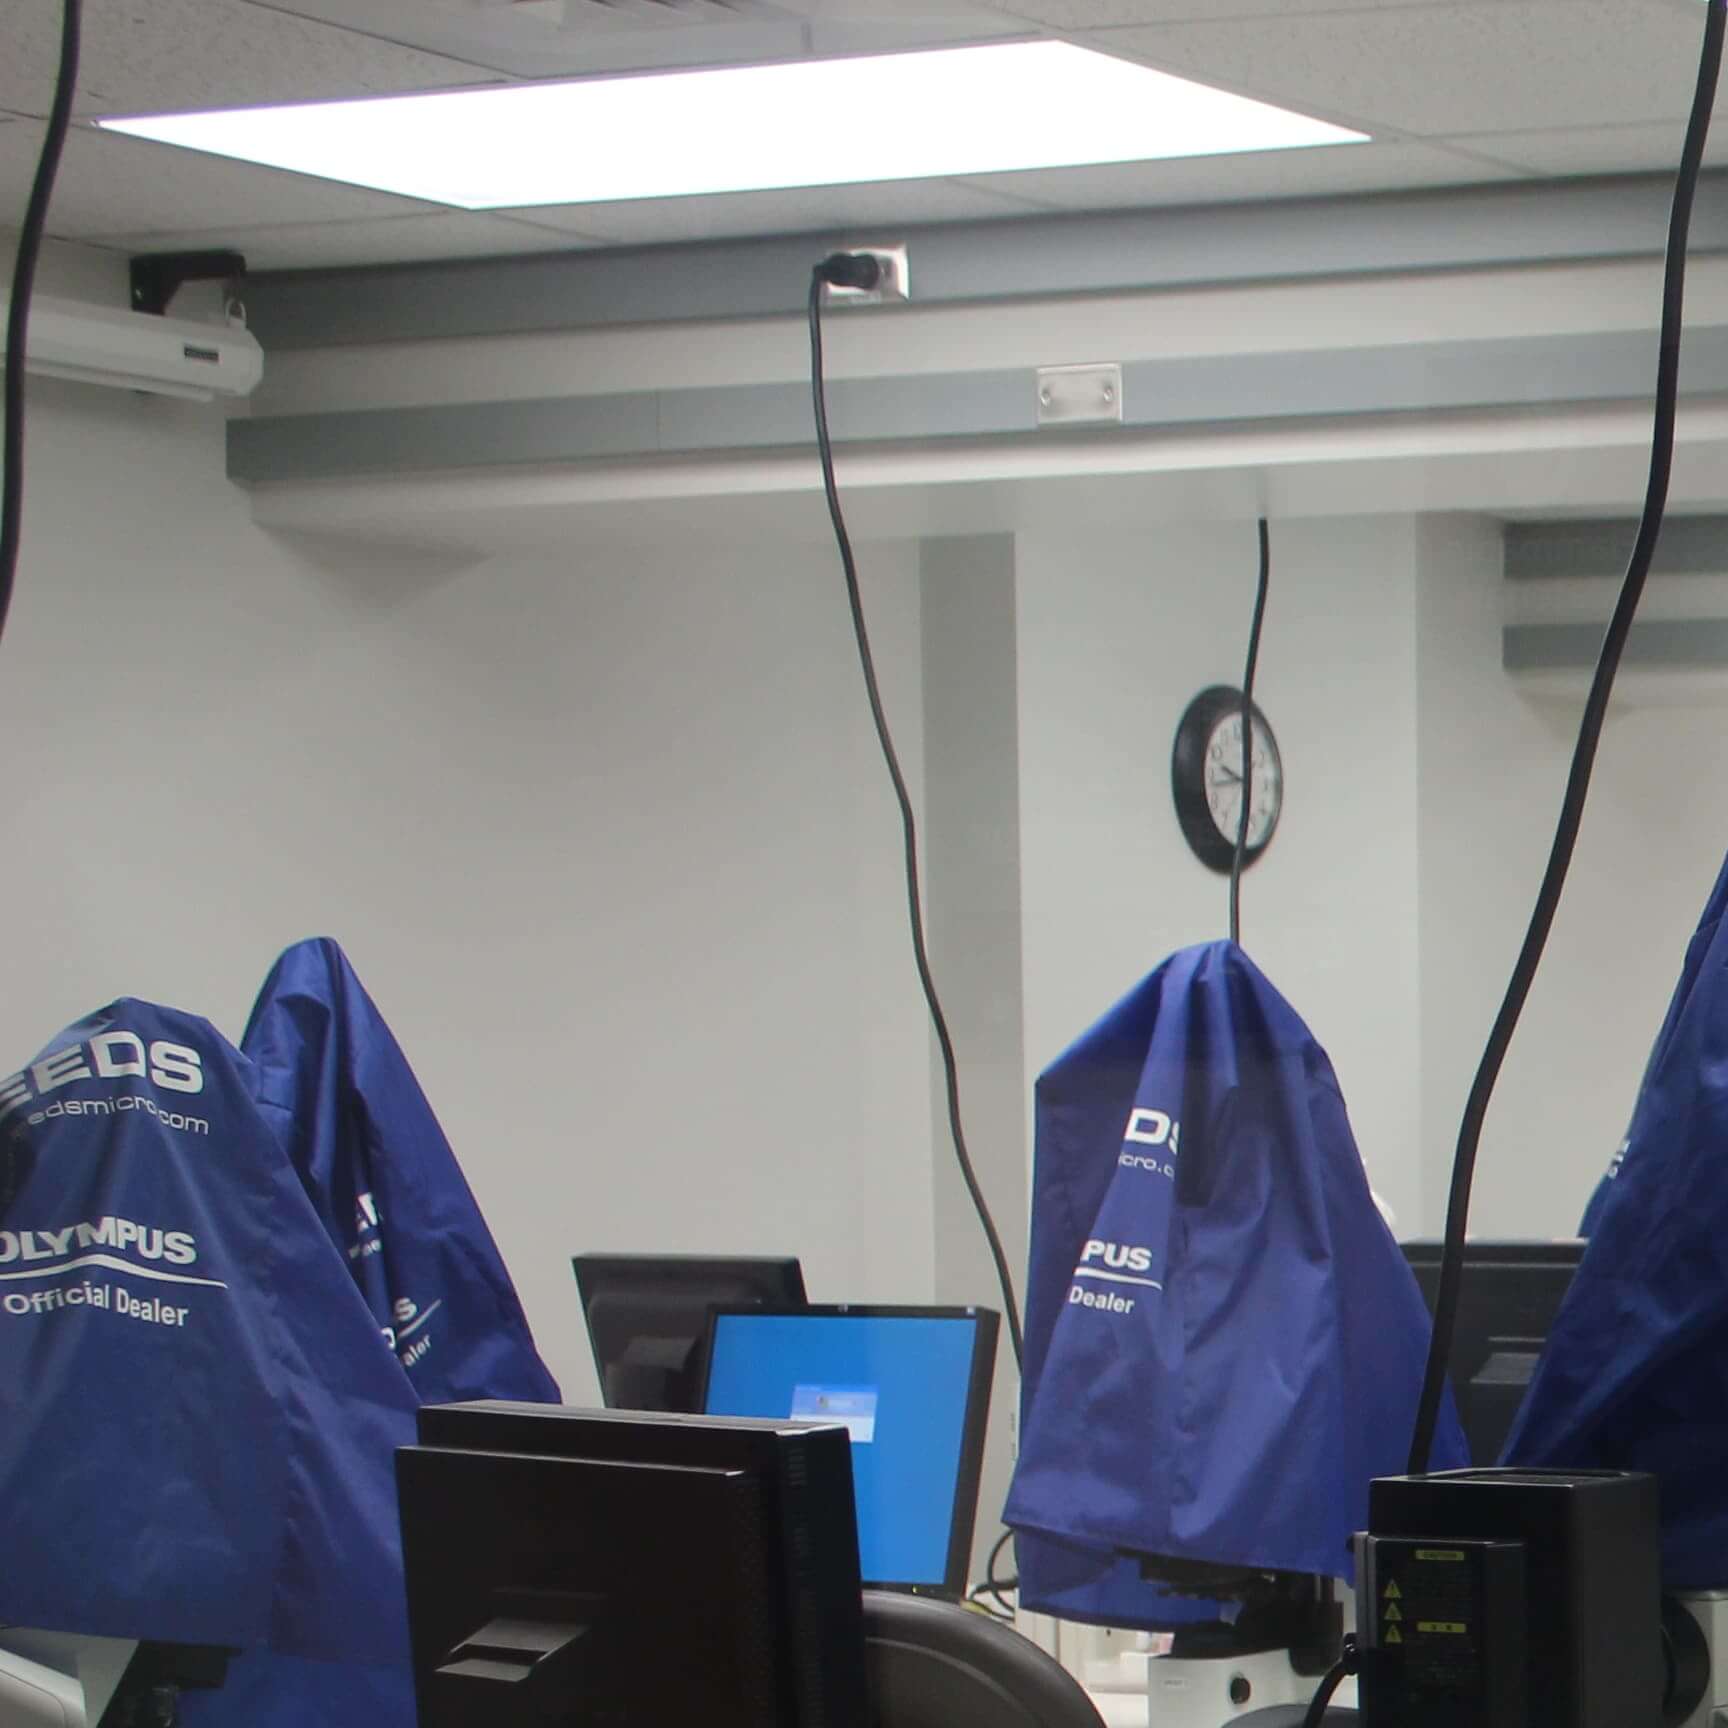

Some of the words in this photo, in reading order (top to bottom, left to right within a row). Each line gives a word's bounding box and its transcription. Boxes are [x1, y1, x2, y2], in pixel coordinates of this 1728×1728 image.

[3, 1281, 110, 1315] Official
[116, 1286, 190, 1327] Dealer
[1069, 1285, 1135, 1315] Dealer
